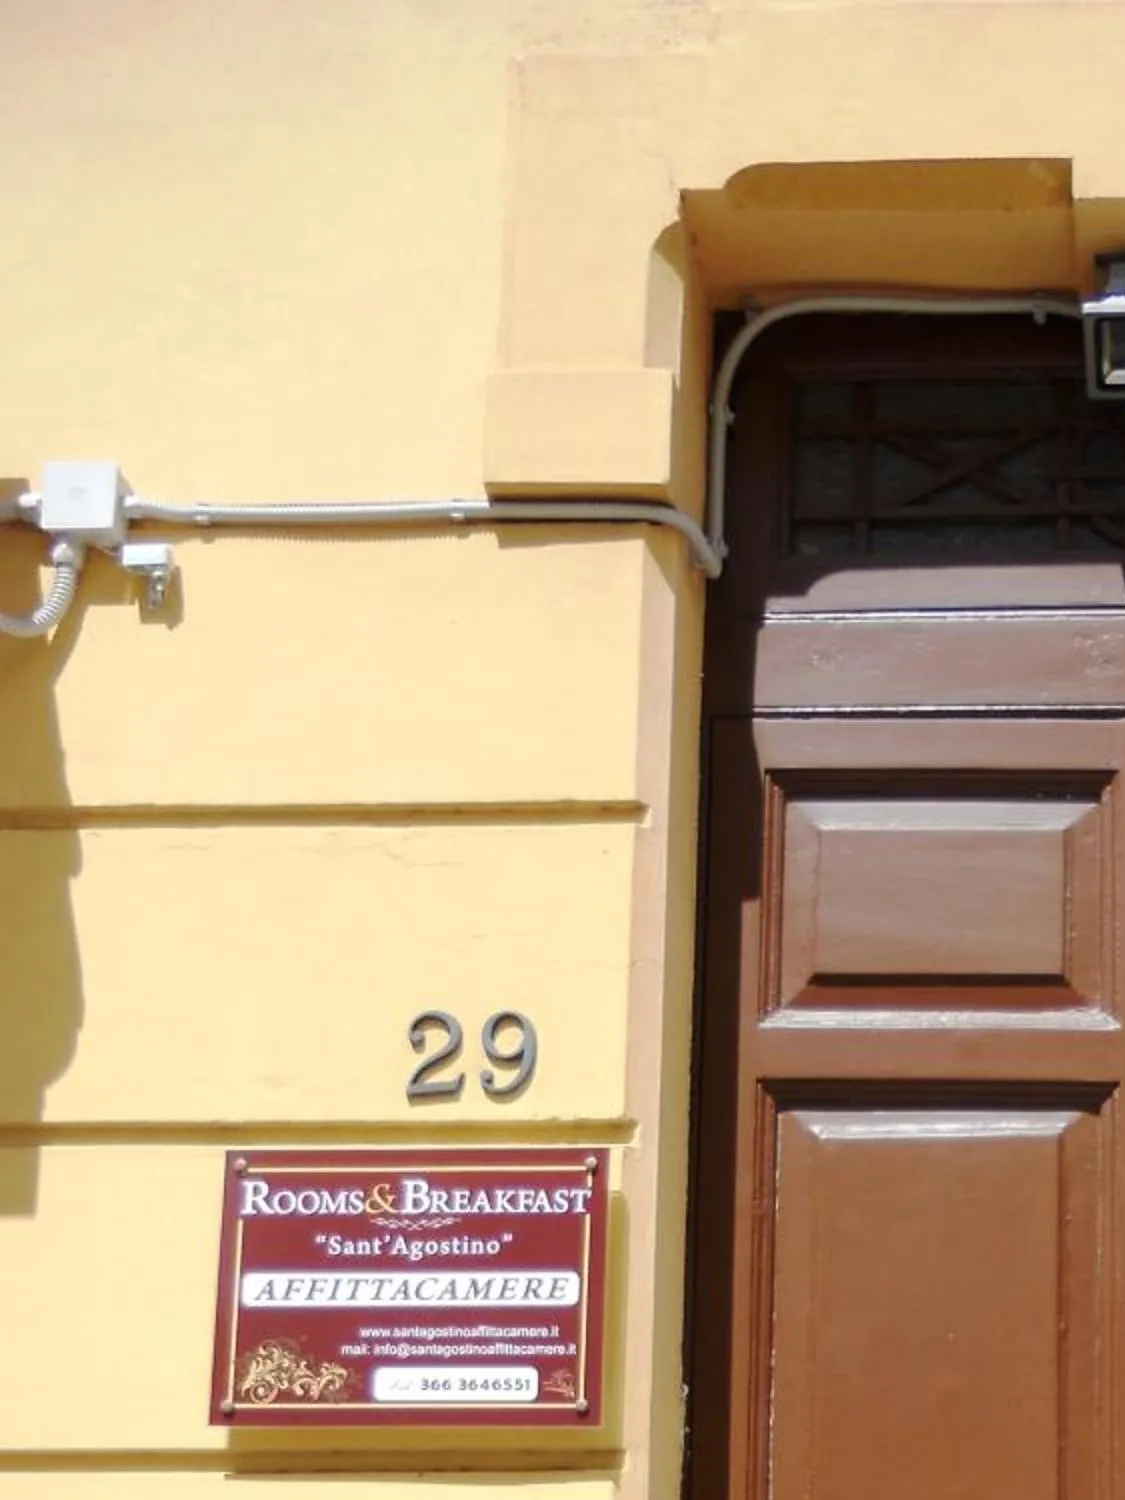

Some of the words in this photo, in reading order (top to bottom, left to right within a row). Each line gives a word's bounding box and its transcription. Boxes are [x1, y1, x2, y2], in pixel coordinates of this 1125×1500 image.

[406, 1009, 537, 1103] 29
[401, 1179, 592, 1214] BREAKFAST
[253, 1277, 570, 1301] AFFITTACAMERE
[359, 1325, 559, 1340] www.santagostinoaffittacamere.it
[421, 1378, 451, 1391] 366
[458, 1378, 531, 1391] 3646551
